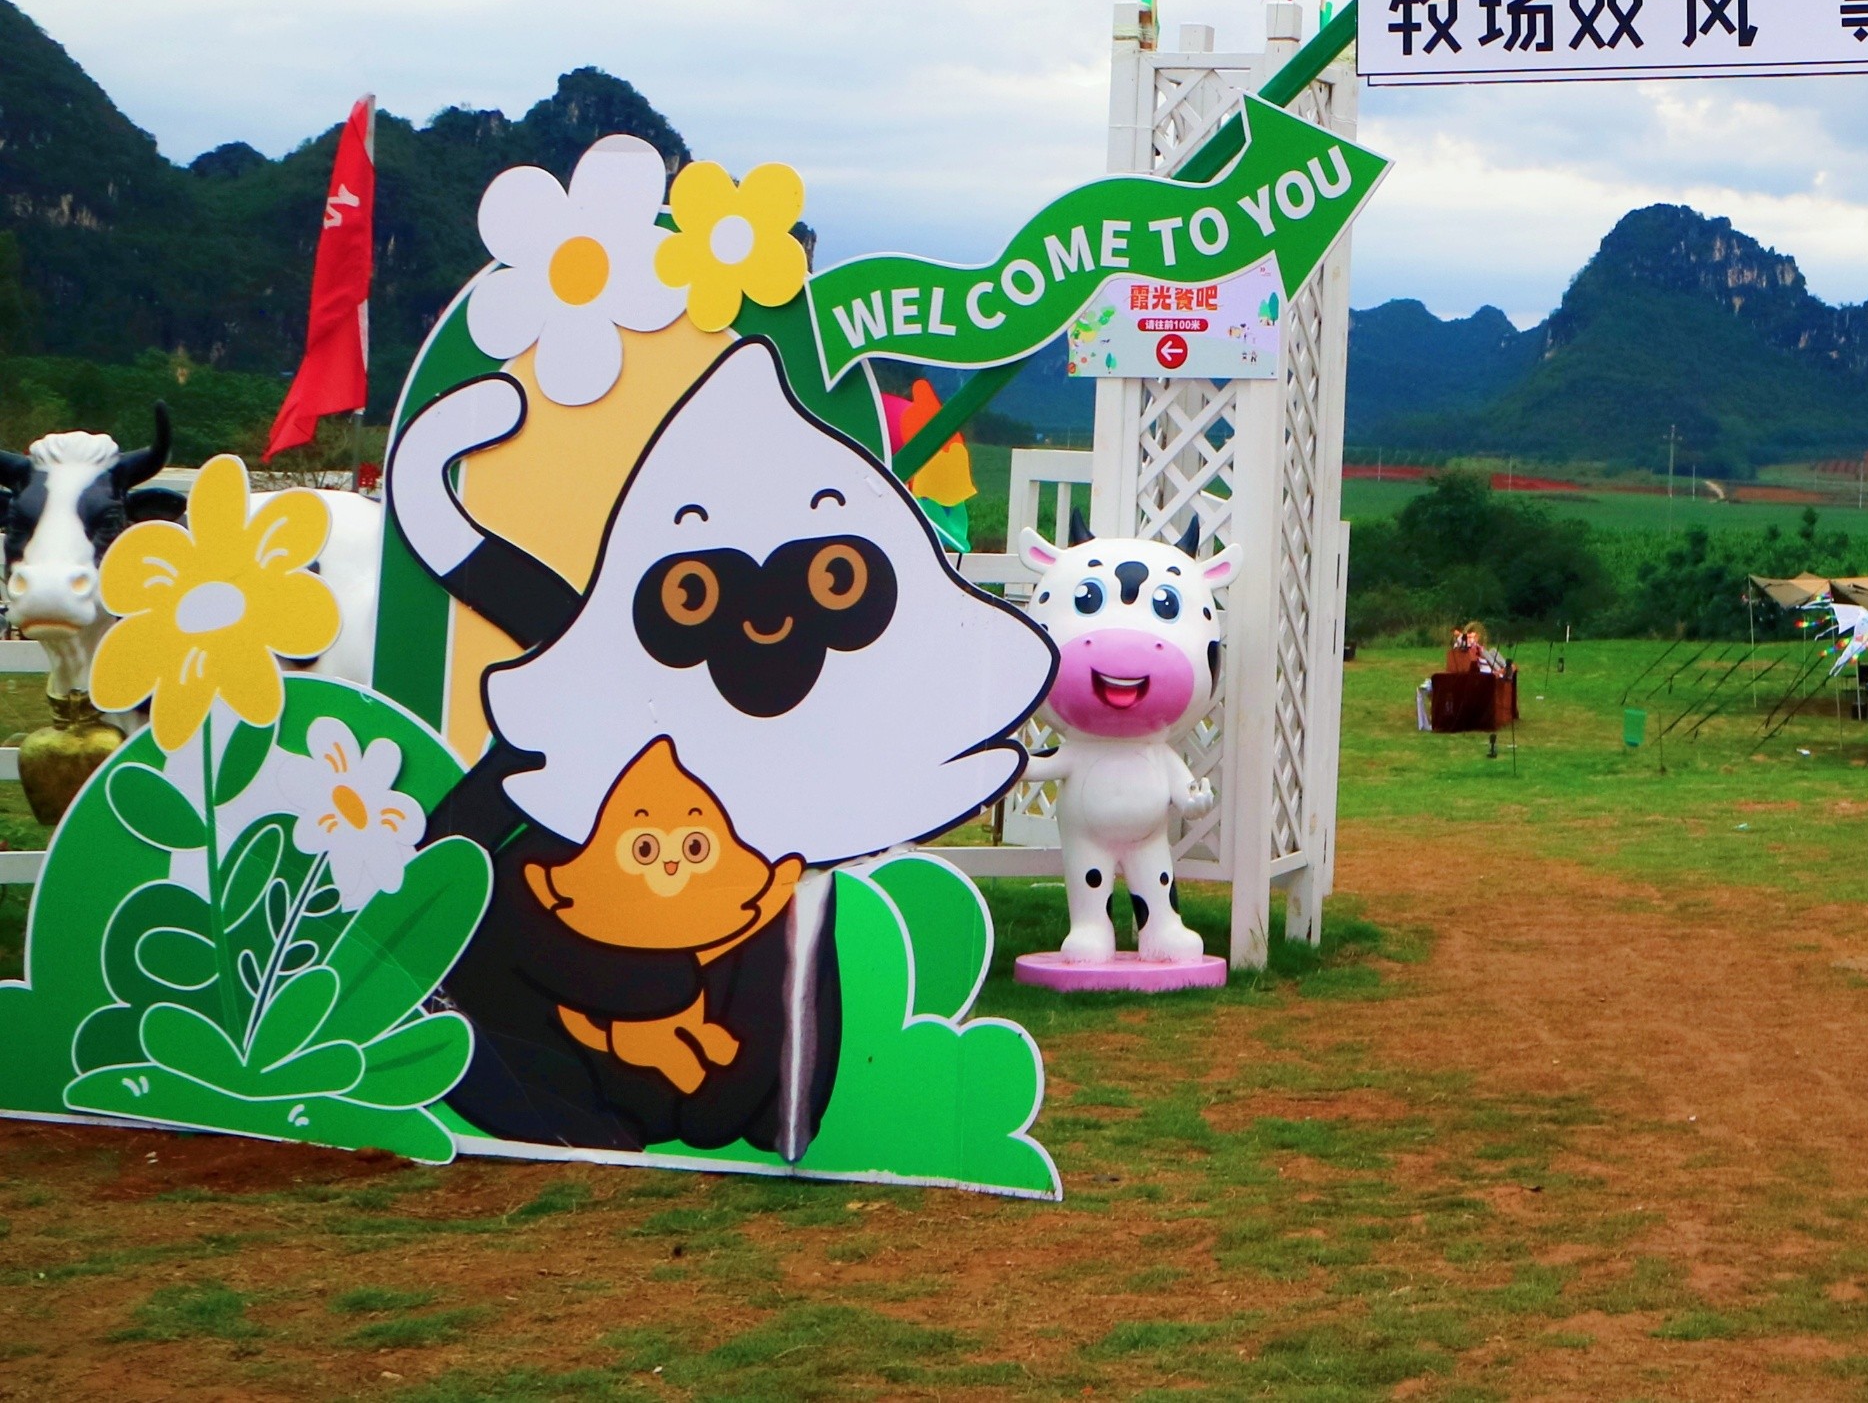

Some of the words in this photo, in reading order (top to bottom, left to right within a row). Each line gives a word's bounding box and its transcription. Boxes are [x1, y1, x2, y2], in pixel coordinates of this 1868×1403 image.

[832, 220, 1131, 349] WELCOME
[1148, 207, 1229, 266] TO
[1237, 145, 1352, 236] YOU
[1129, 284, 1218, 311] 霞光餐吧
[1144, 319, 1201, 331] 请往前100米
